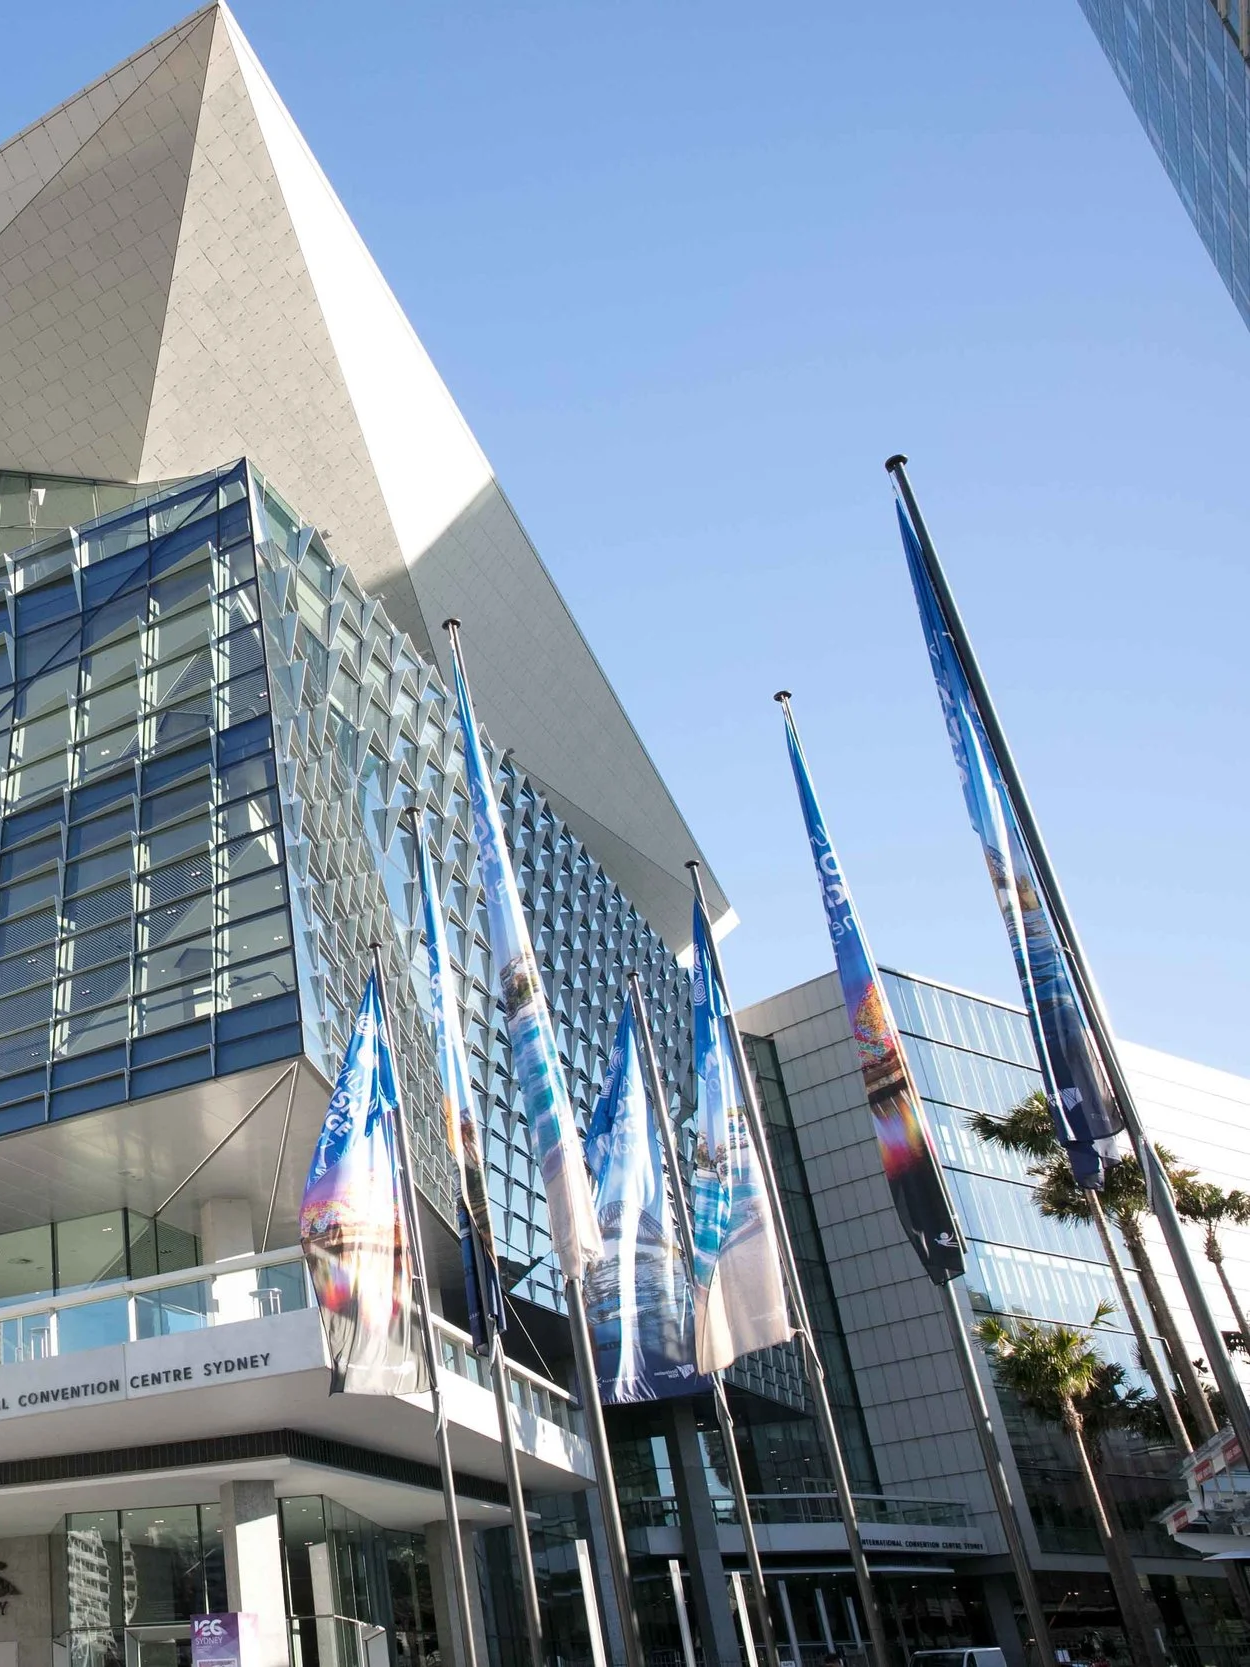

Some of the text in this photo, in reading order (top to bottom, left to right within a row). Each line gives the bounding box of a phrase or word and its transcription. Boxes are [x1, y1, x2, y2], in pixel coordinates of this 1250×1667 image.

[18, 1379, 120, 1407] CONVENTION
[130, 1366, 193, 1389] CENTRE
[203, 1352, 270, 1377] SYDNEY
[861, 1539, 984, 1550] NTERNATIONAL CONVENTION CENTRE SYDNEY
[195, 1637, 223, 1646] SYDNEY
